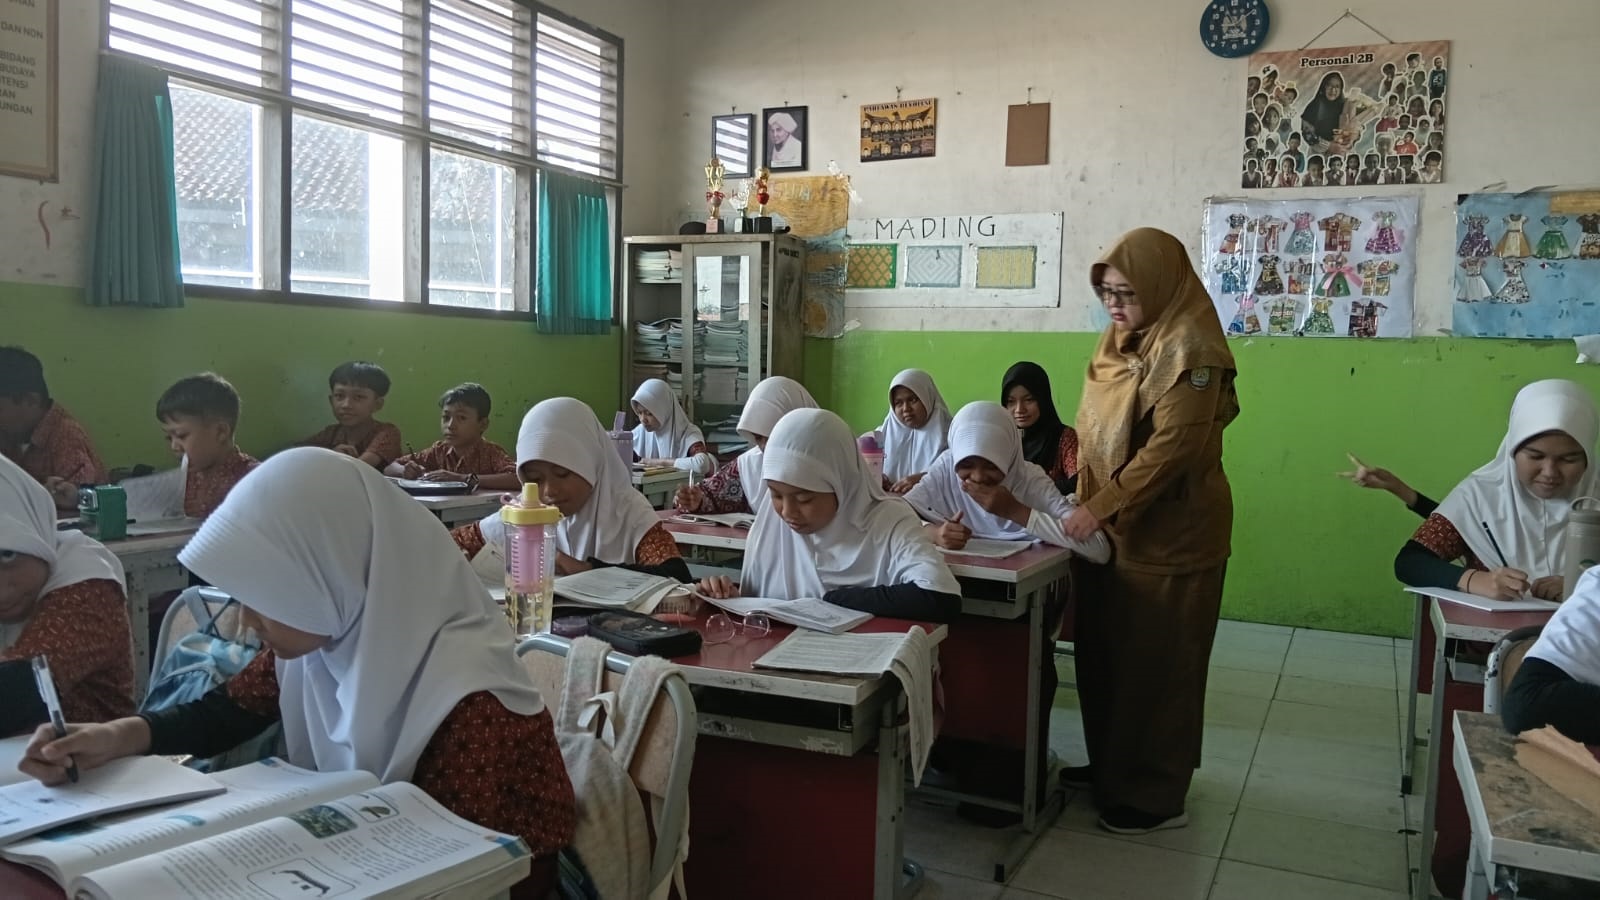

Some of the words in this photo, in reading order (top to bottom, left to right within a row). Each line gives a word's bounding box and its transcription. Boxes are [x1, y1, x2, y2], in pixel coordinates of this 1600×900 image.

[1, 21, 21, 33] DAN
[23, 26, 43, 39] NON
[1301, 54, 1354, 67] Personal
[1357, 53, 1374, 64] 2B
[0, 76, 29, 88] TENSI
[875, 216, 996, 239] MADING
